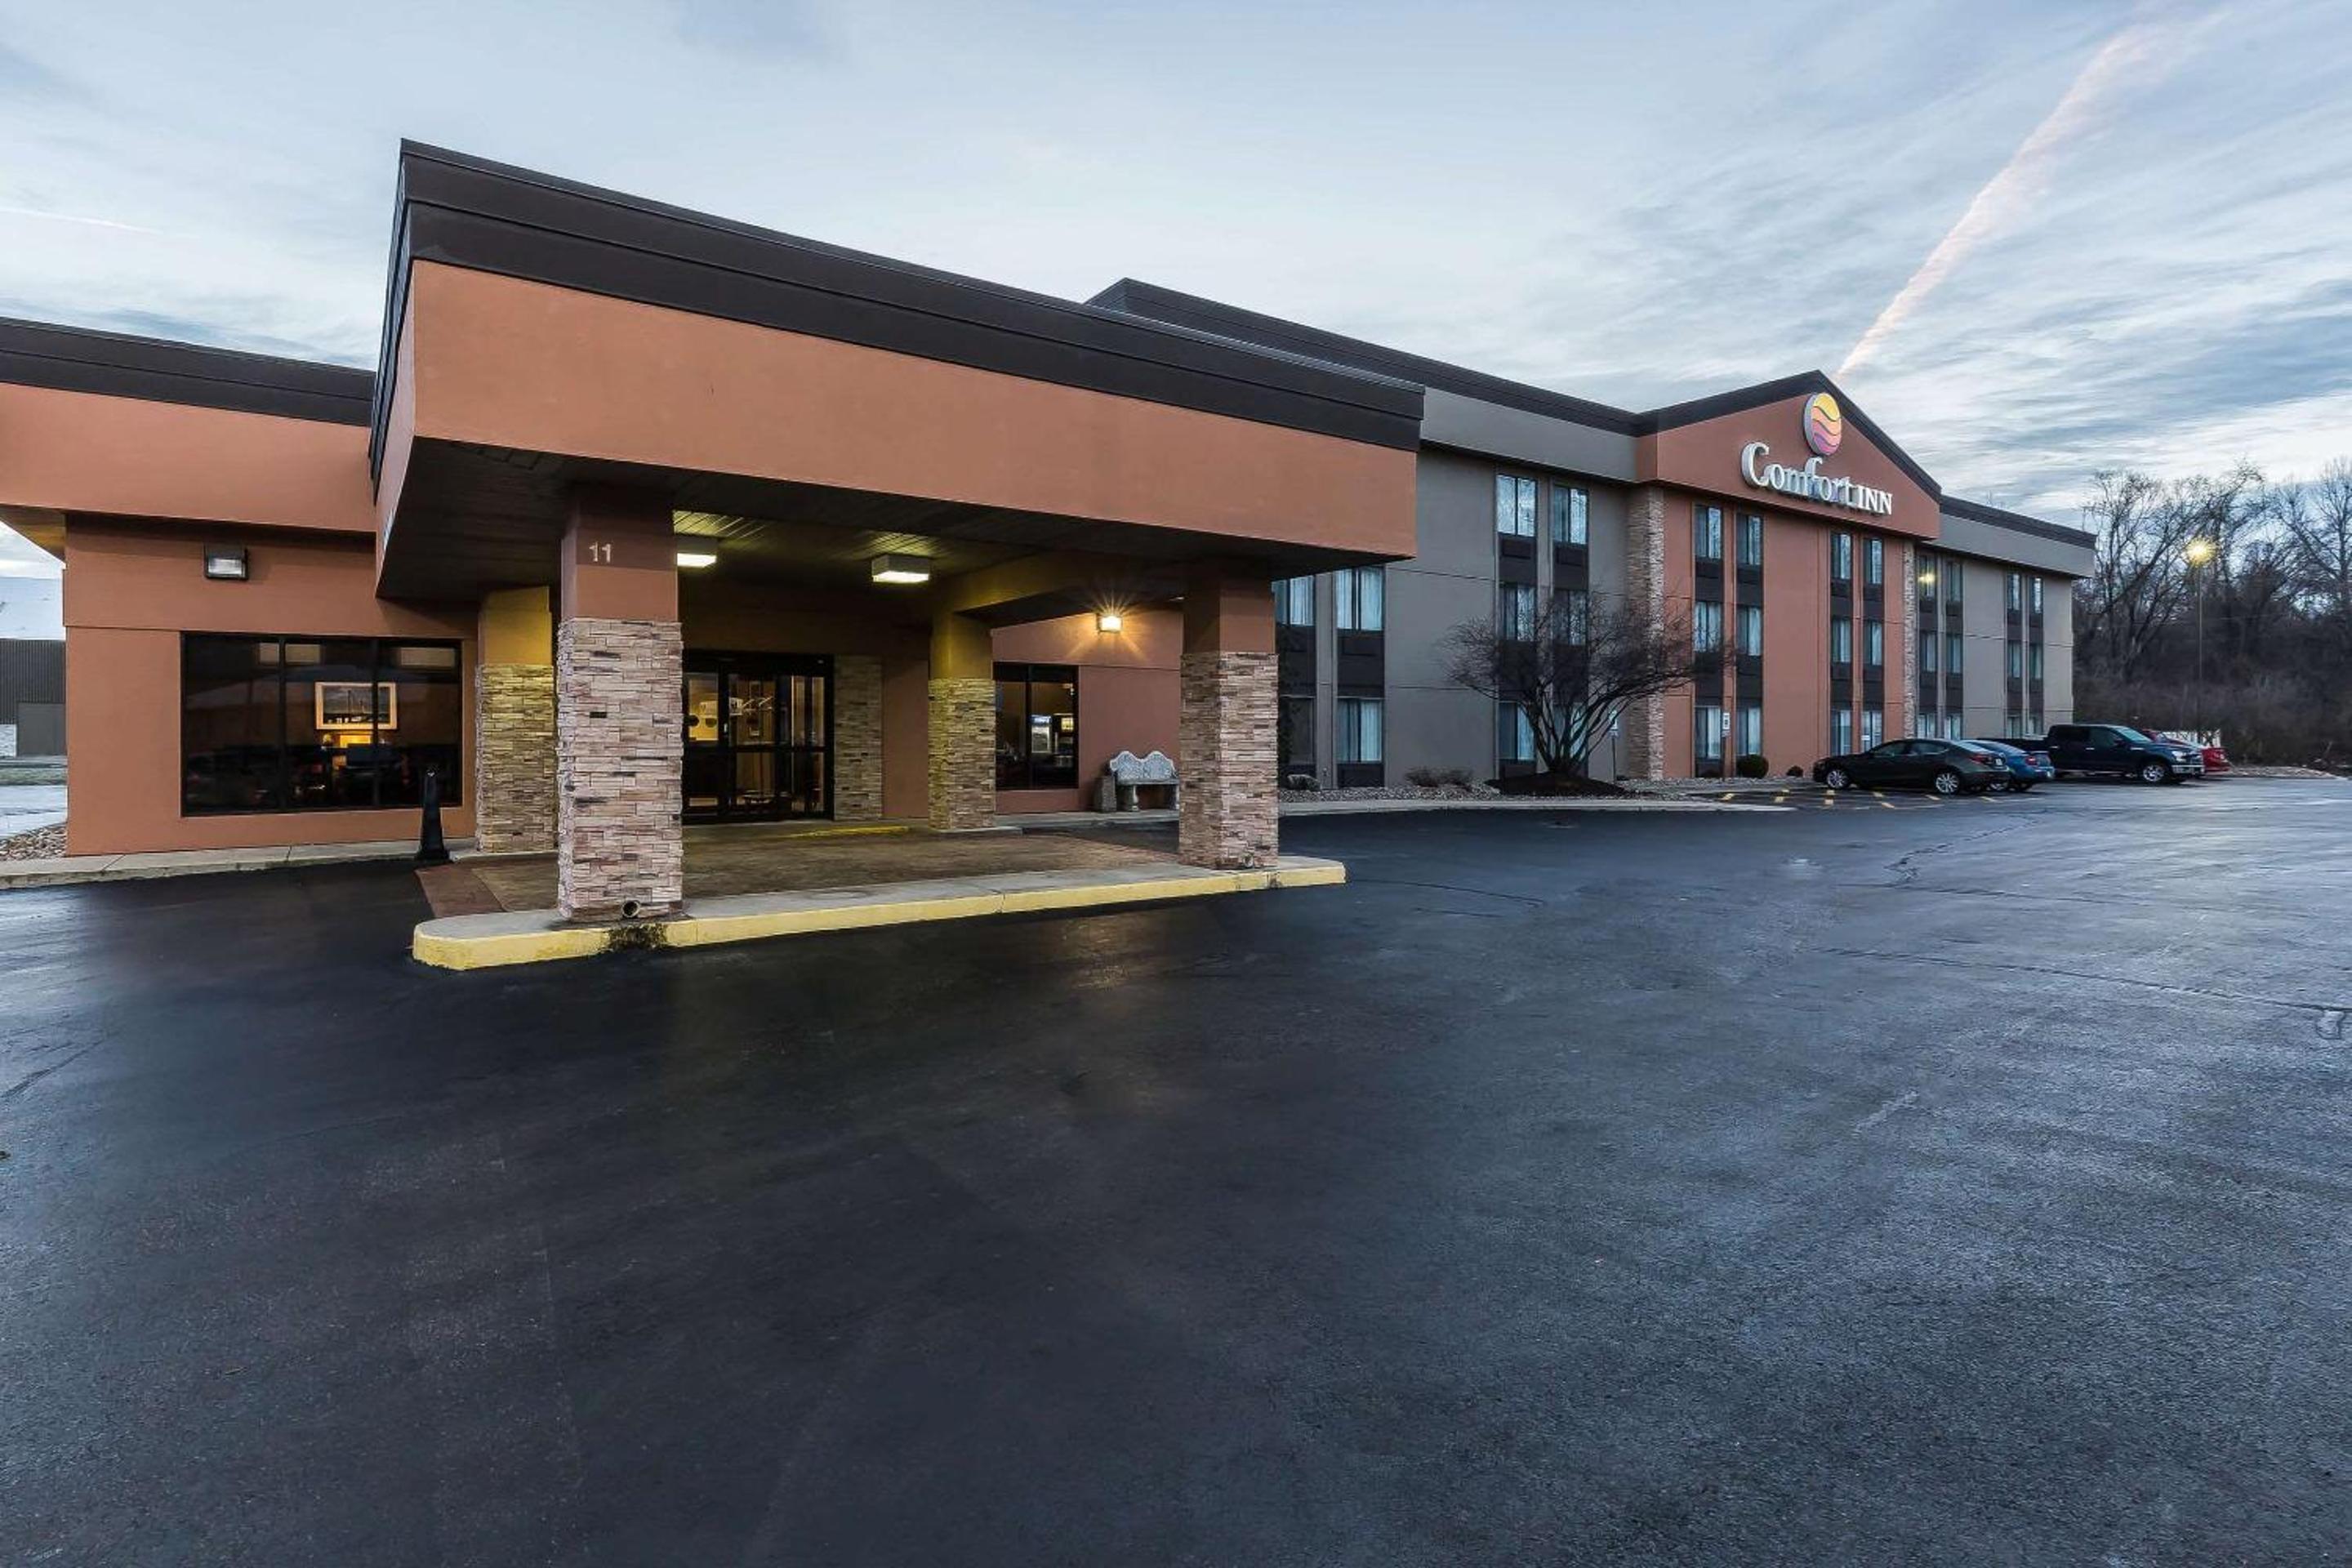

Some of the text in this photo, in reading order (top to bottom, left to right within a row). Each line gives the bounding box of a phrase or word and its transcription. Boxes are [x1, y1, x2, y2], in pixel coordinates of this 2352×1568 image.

[1741, 442, 1893, 514] Comfort INN
[589, 541, 612, 563] 11
